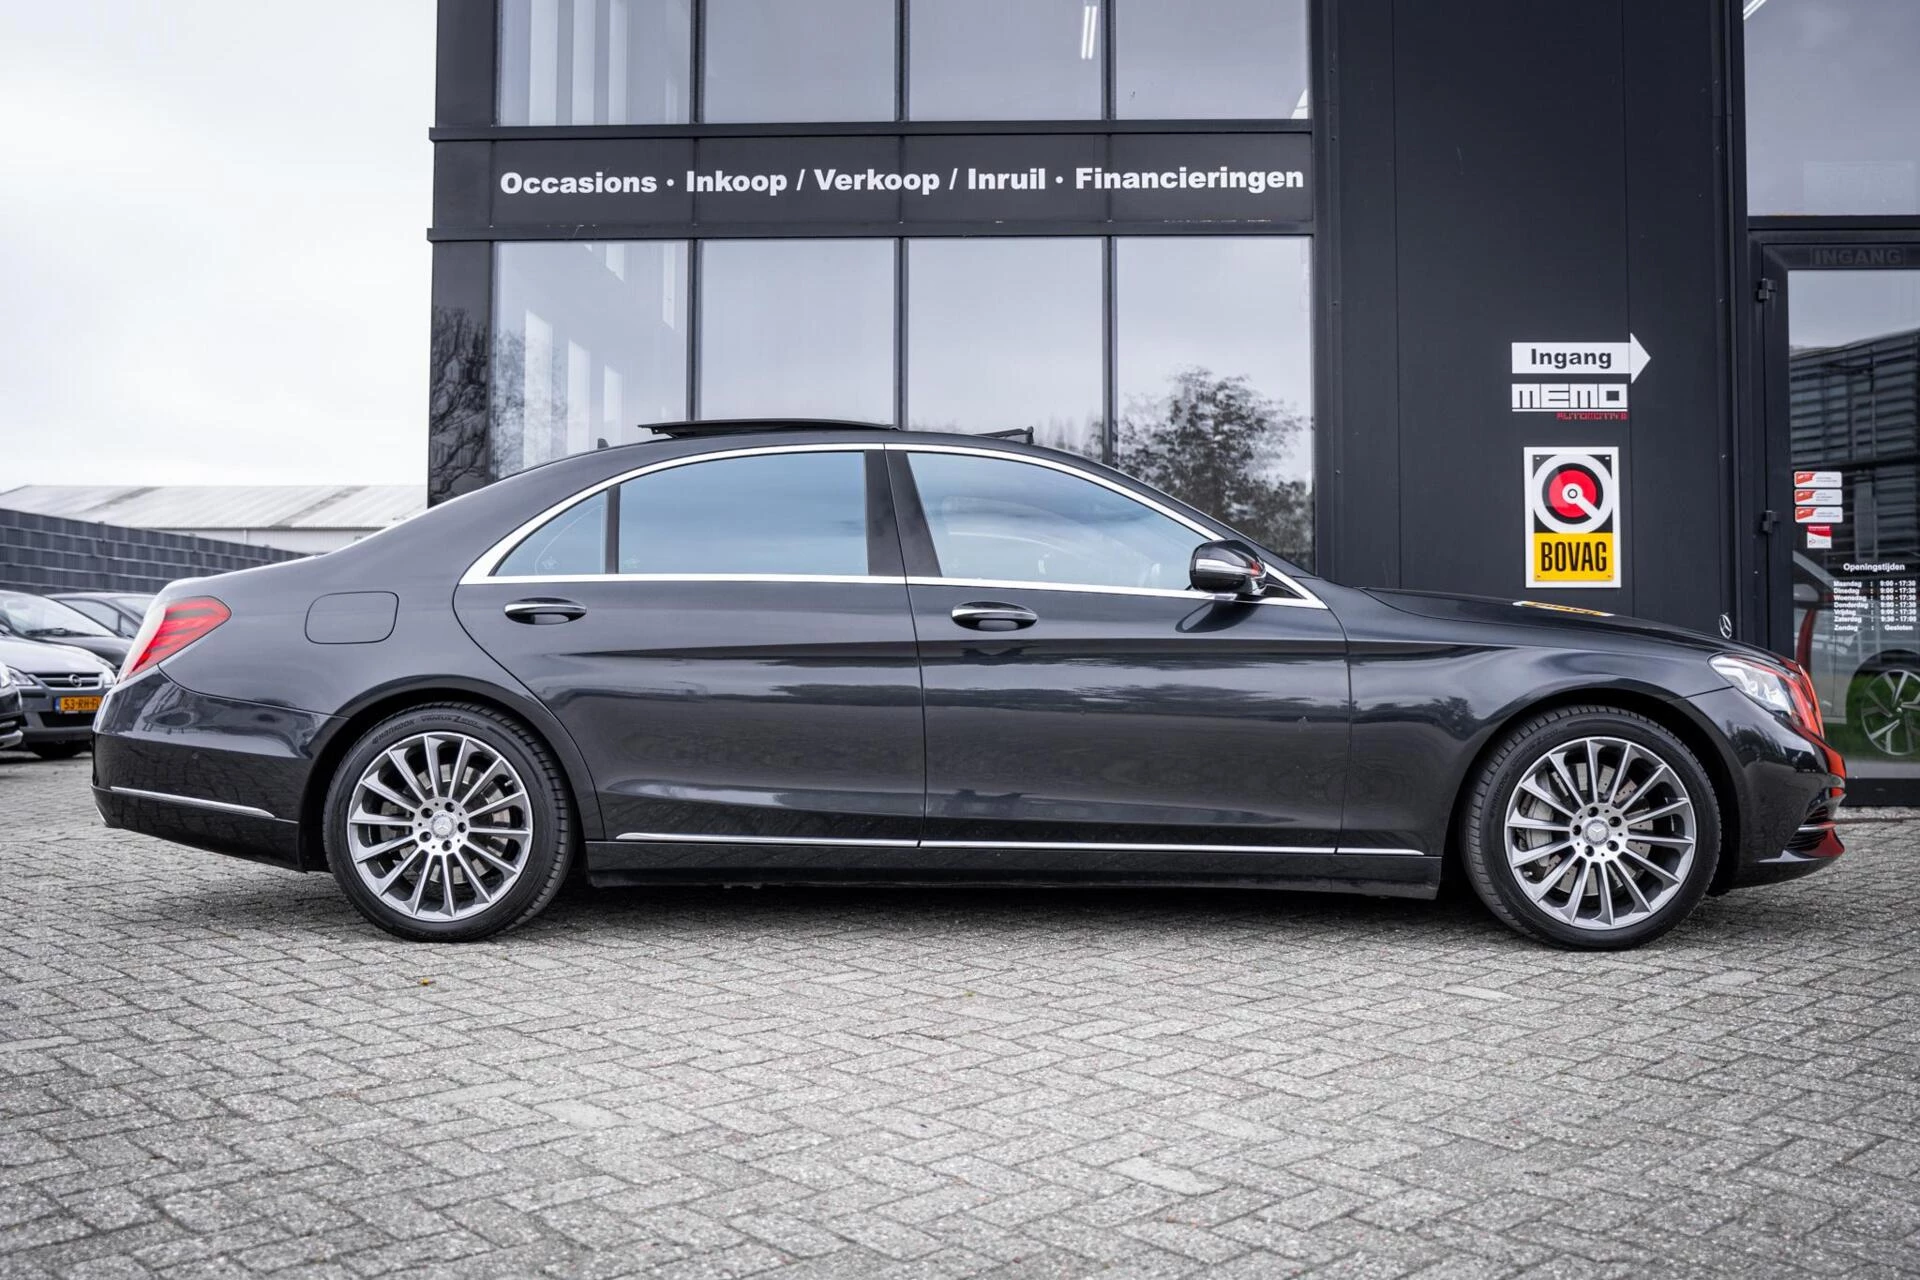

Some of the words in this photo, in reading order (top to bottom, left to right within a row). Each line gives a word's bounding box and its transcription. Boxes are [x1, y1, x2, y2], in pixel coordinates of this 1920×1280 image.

[500, 171, 658, 194] Occasions
[686, 170, 788, 197] Inkoop
[813, 168, 940, 196] Verkoop
[968, 167, 1046, 190] Inruil
[1075, 166, 1304, 194] Financieringen
[1814, 248, 1902, 265] INGANG
[1530, 348, 1612, 369] Ingang
[1512, 383, 1628, 409] MEMO
[1540, 541, 1607, 572] BOVAG
[1843, 562, 1905, 572] Openingstijden
